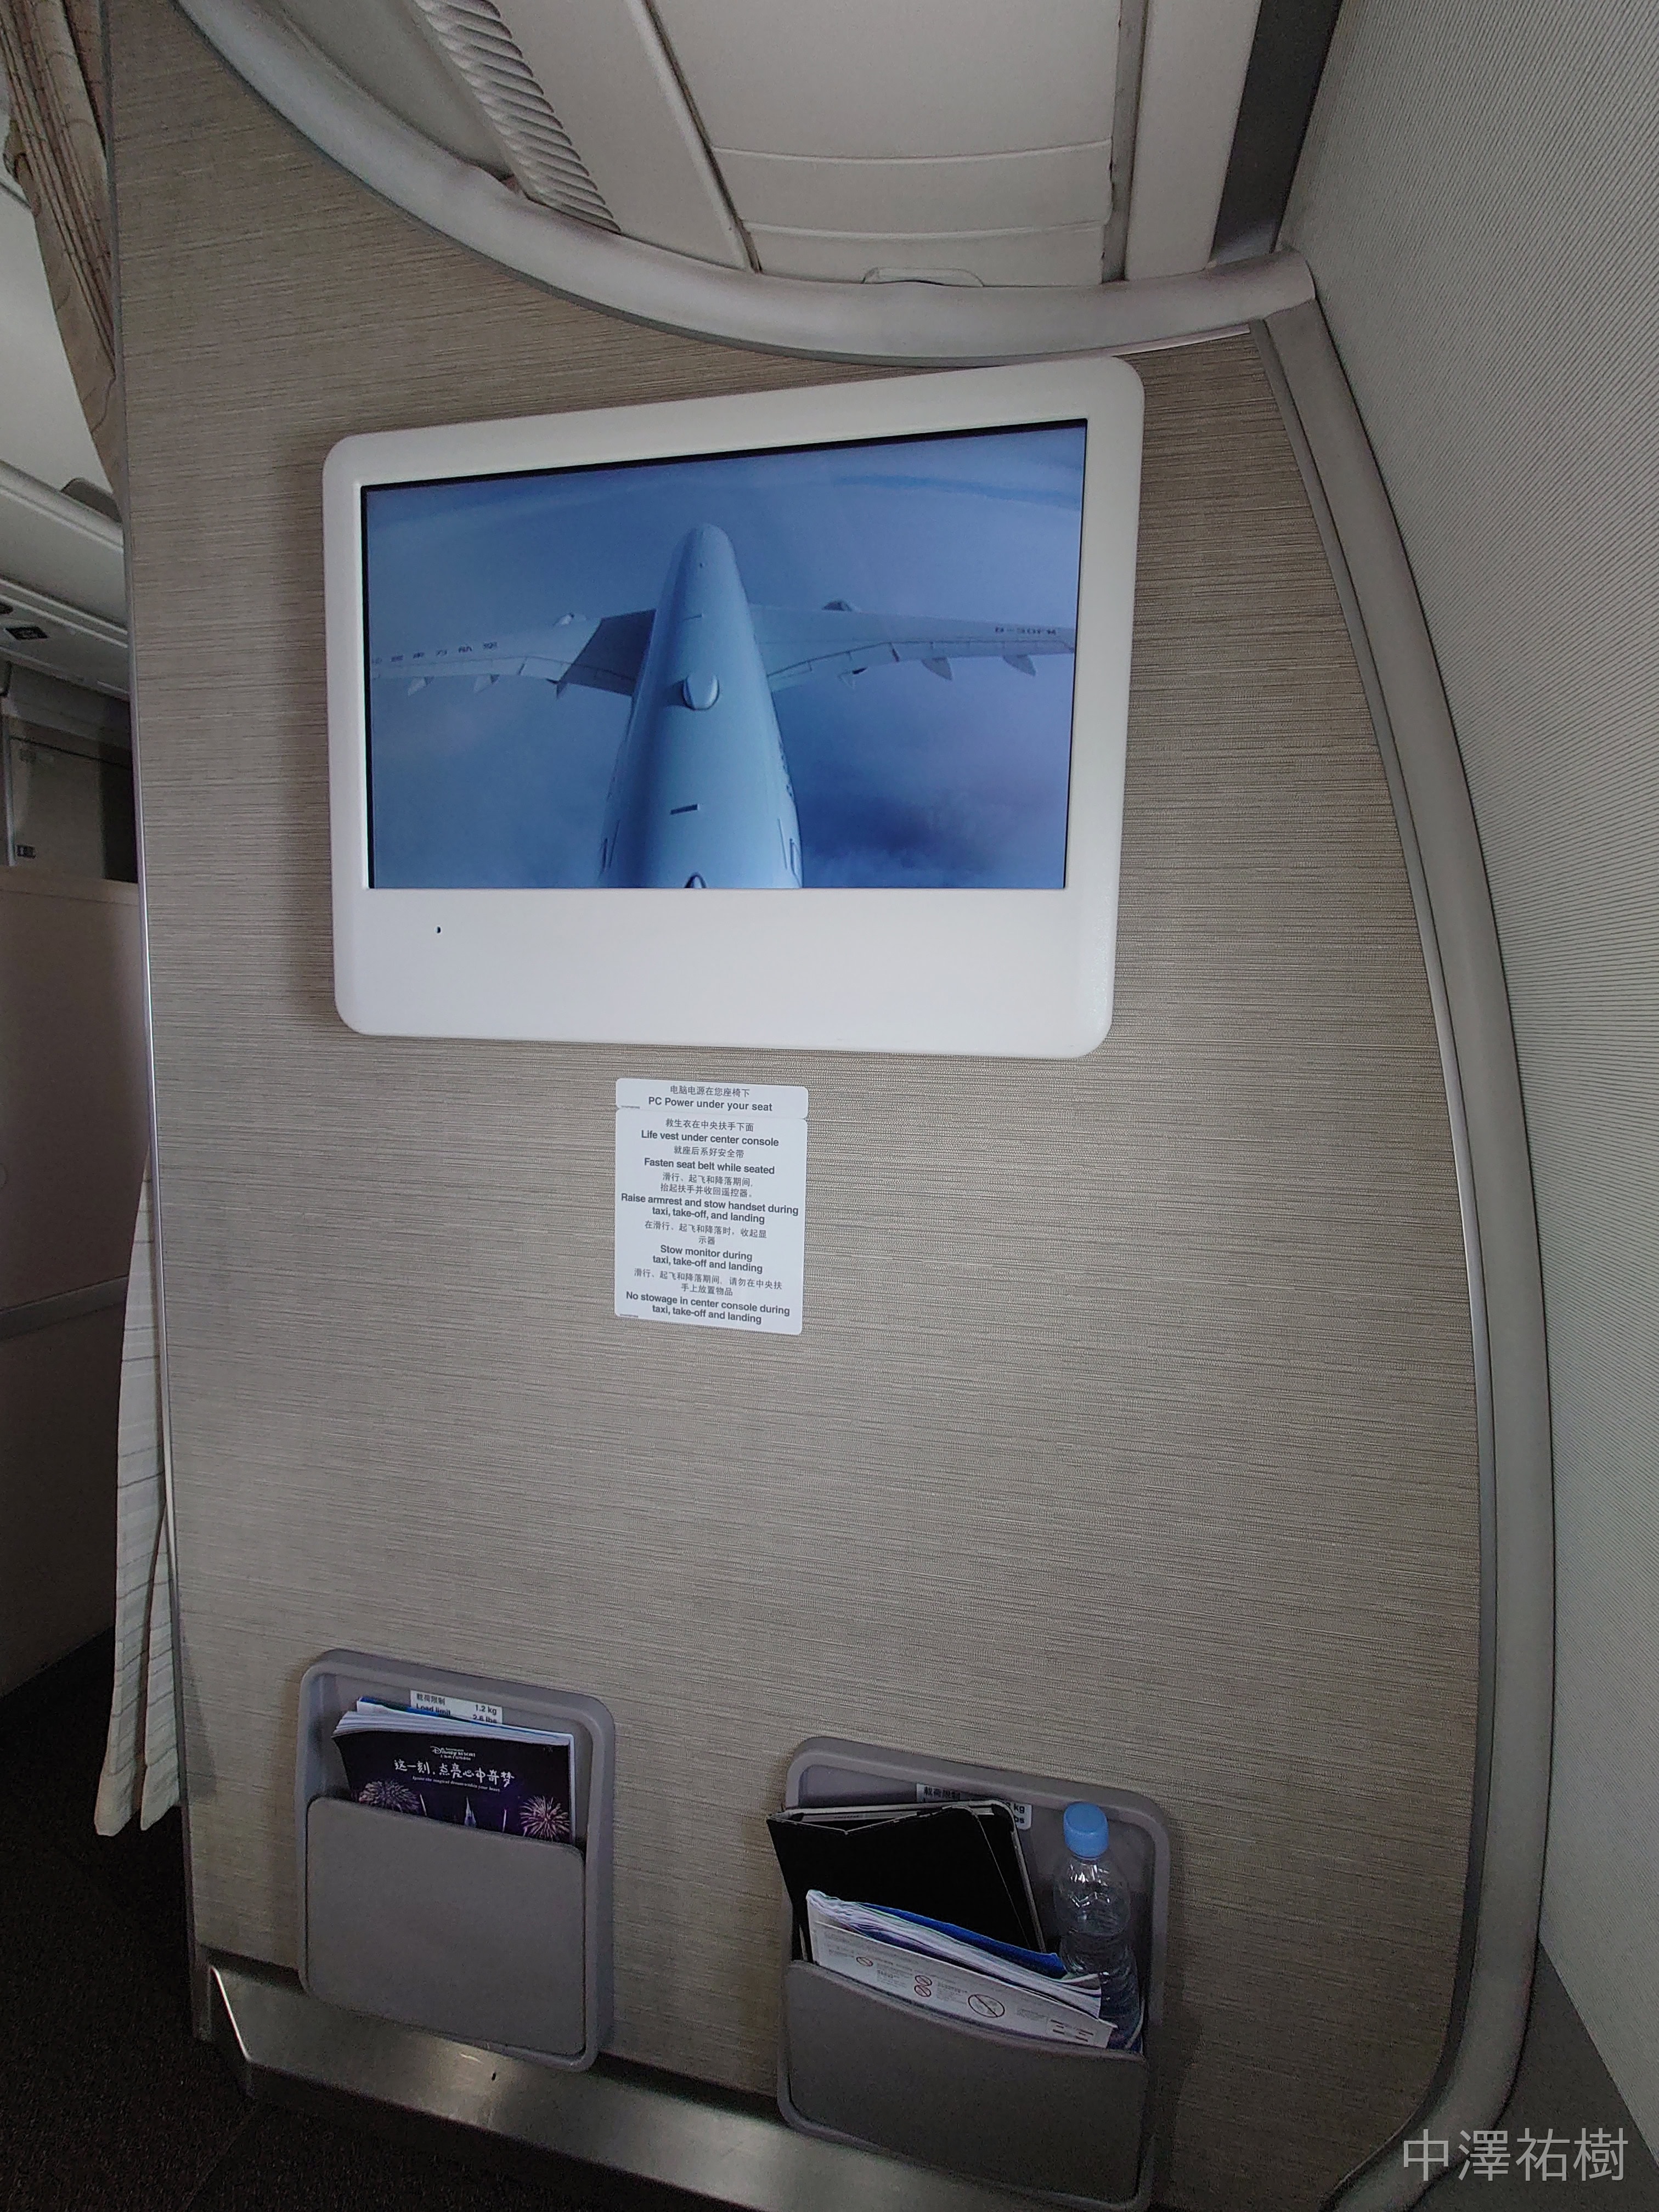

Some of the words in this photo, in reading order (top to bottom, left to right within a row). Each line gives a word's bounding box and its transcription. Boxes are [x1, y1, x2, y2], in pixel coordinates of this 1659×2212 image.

[670, 1085, 749, 1098] 电脑电源在您座椅下
[649, 1097, 662, 1105] PC
[665, 1097, 694, 1107] Power
[697, 1099, 725, 1108] under
[727, 1101, 750, 1111] your
[665, 1119, 754, 1132] 救生衣在中央扶手下面
[641, 1130, 658, 1139] Life
[681, 1132, 708, 1143] under
[710, 1134, 740, 1144] center
[741, 1136, 780, 1147] console
[674, 1146, 744, 1159] 就座后系好安全带
[645, 1158, 674, 1167] Fasten
[698, 1161, 715, 1170] belt
[717, 1163, 741, 1172] while
[743, 1166, 775, 1174] seated
[622, 1193, 646, 1203] Raise
[648, 1197, 682, 1206] armrest
[685, 1198, 702, 1207] and
[703, 1199, 726, 1209] stow
[728, 1201, 766, 1212] handset
[768, 1204, 799, 1217] during
[652, 1206, 671, 1217] taxi,
[673, 1208, 709, 1220] take-off,
[710, 1211, 728, 1220] and
[731, 1212, 765, 1225] landing
[699, 1236, 715, 1245] 示器
[661, 1245, 683, 1254] Stow
[685, 1248, 720, 1258] monitor
[723, 1250, 752, 1262] during
[653, 1255, 671, 1266] taxi,
[673, 1257, 707, 1267] take-off
[709, 1261, 726, 1269] and
[729, 1261, 763, 1274] landing
[681, 1283, 732, 1296] 手上放置物品
[627, 1291, 639, 1300] No
[641, 1294, 678, 1305] stowage
[680, 1296, 688, 1305] in
[691, 1299, 719, 1308] center
[721, 1302, 758, 1312] console
[760, 1305, 789, 1317] during
[652, 1305, 670, 1315] taxi,
[673, 1307, 706, 1317] take-off
[708, 1311, 725, 1319] and
[728, 1312, 761, 1324] landing
[416, 1703, 434, 1712] Load
[475, 1704, 486, 1712] 1.2
[488, 1706, 497, 1716] kg
[1014, 1803, 1025, 1814] kg
